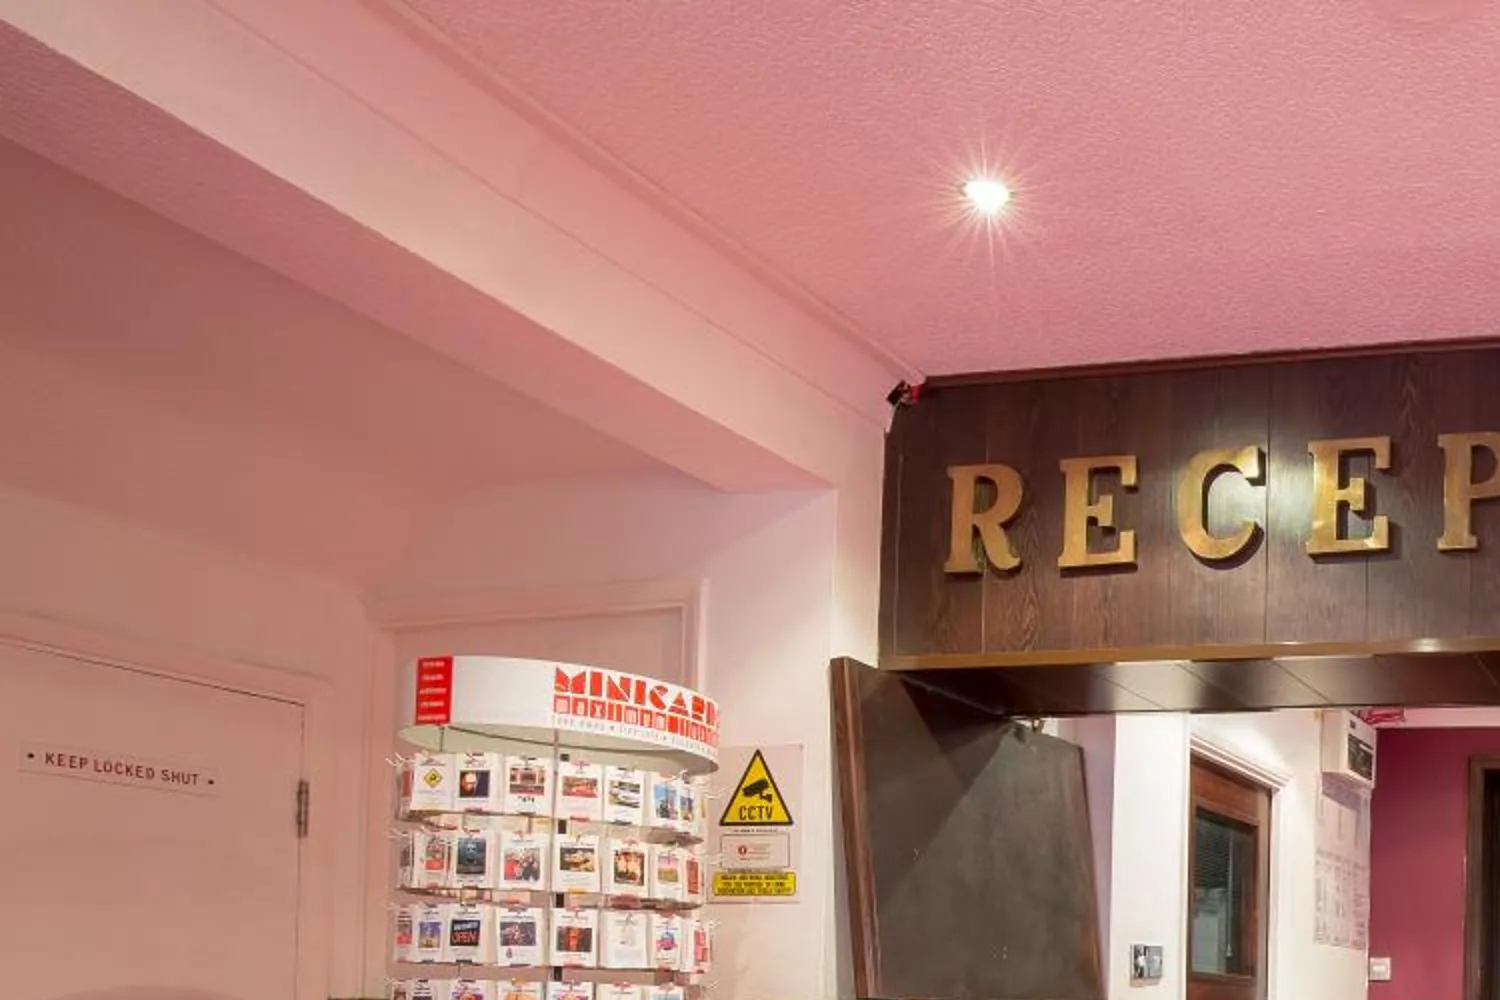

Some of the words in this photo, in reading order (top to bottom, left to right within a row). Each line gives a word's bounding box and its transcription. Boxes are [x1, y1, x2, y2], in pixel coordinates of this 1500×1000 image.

[45, 752, 89, 770] KEEP
[94, 759, 155, 780] LOCKED
[161, 769, 199, 786] SHUT
[739, 805, 774, 821] CCTV
